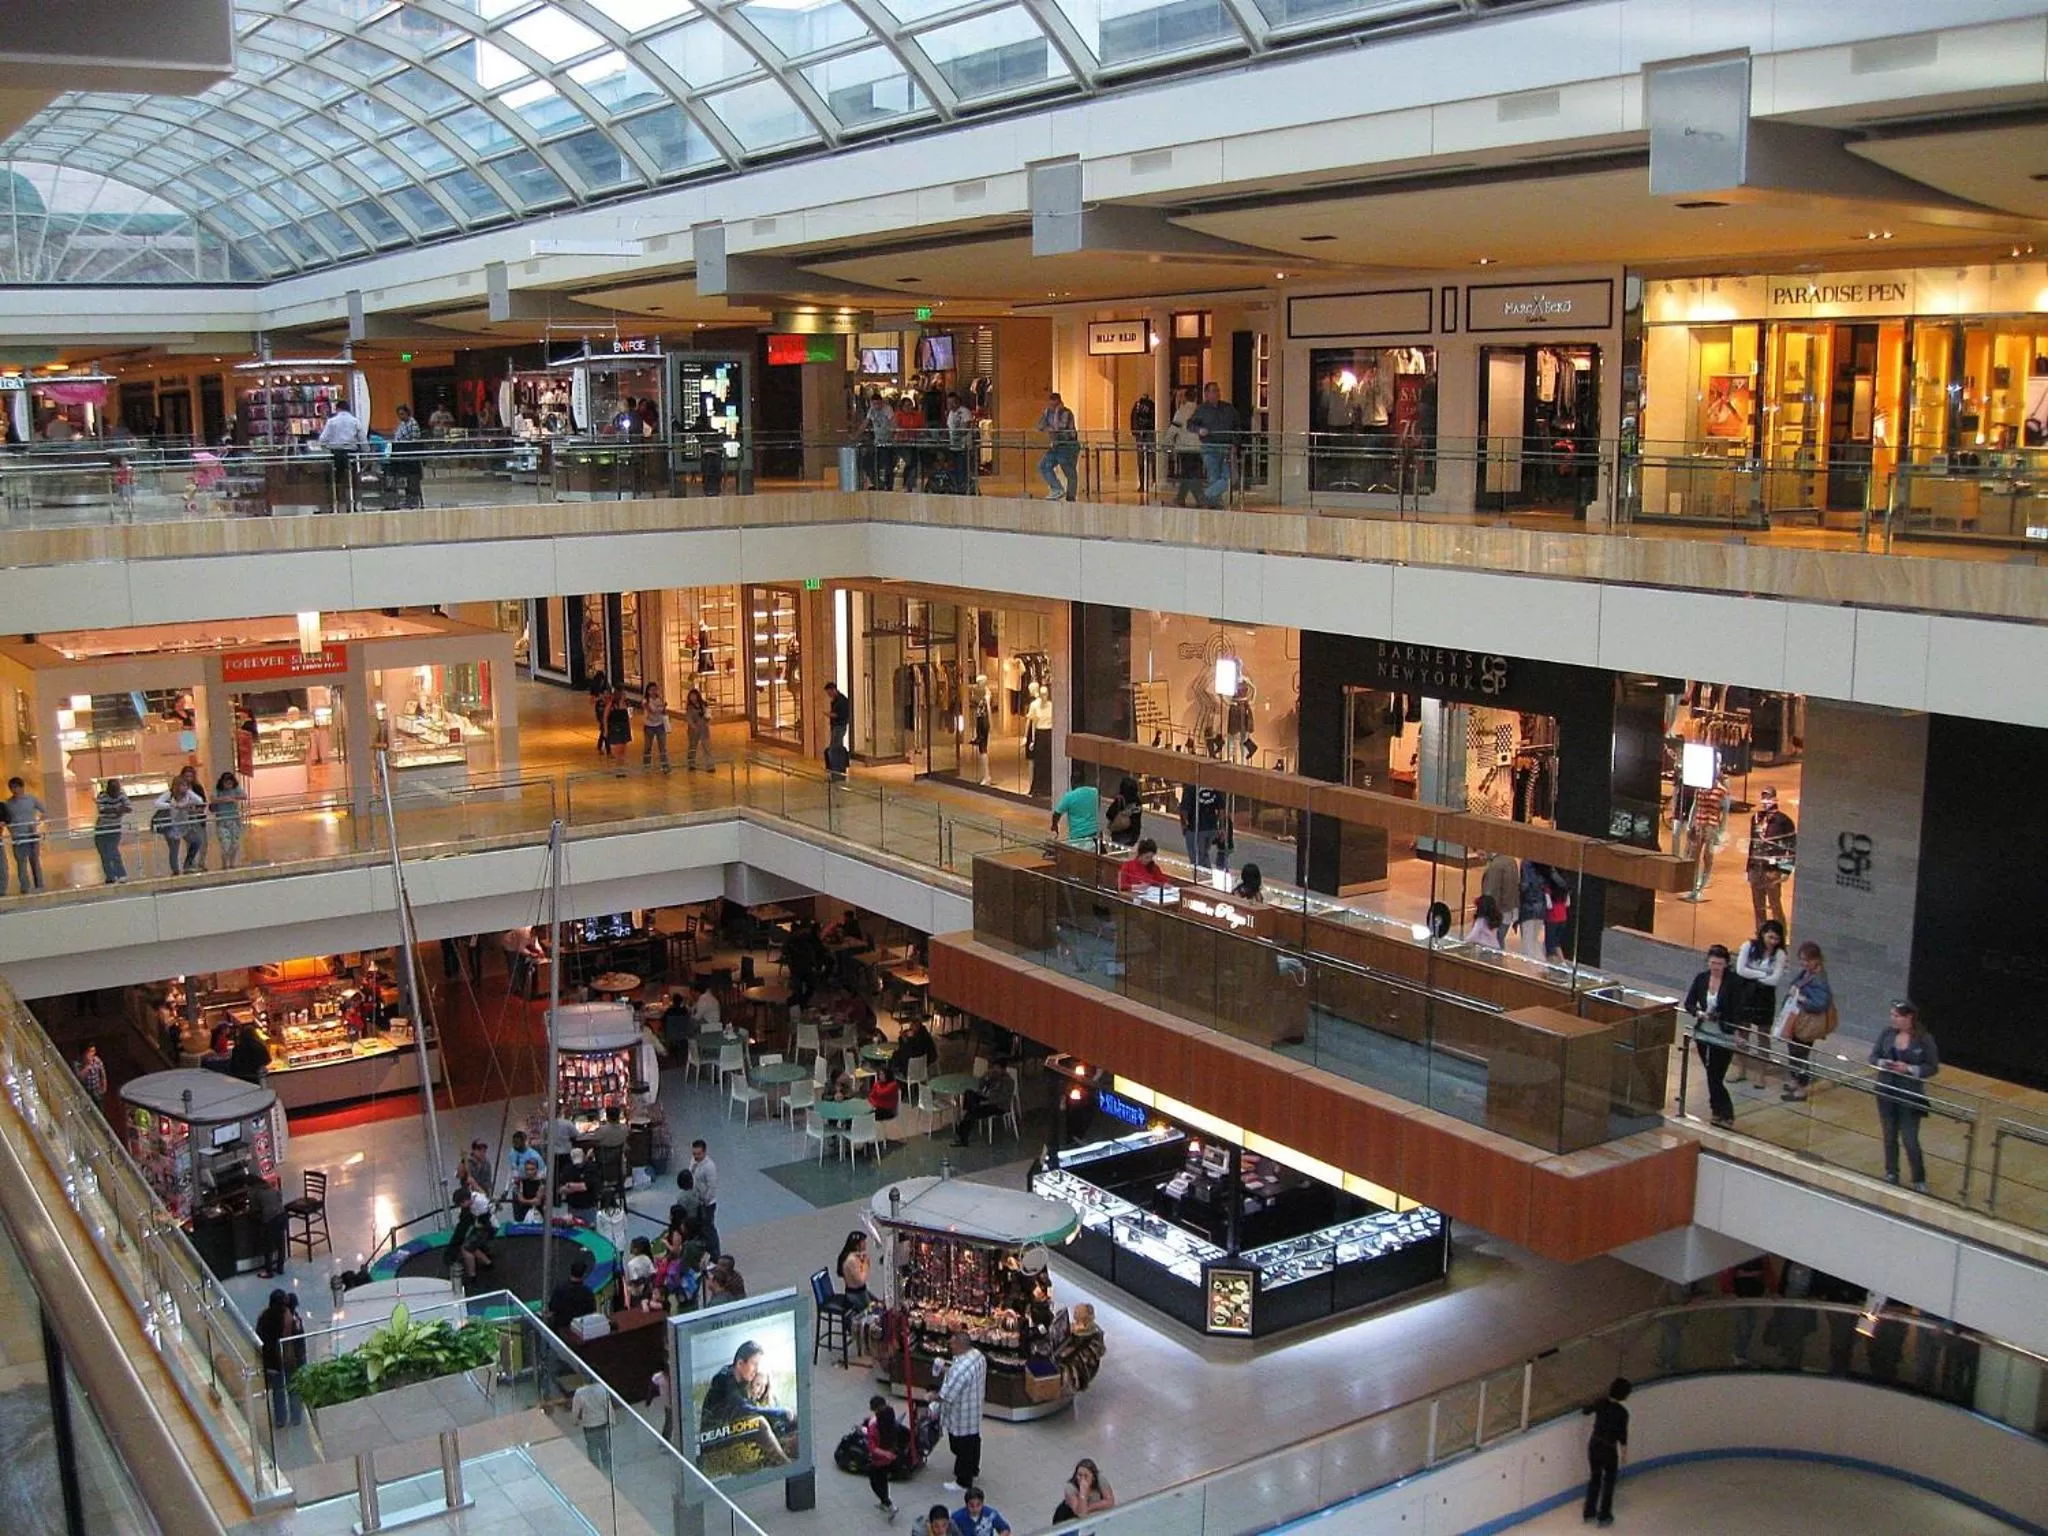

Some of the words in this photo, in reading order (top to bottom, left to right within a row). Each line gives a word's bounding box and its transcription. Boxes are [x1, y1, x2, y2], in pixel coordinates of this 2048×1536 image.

[1774, 285, 1863, 304] PARADISE
[1867, 283, 1906, 301] PEN
[225, 656, 285, 670] FOREVER
[1378, 642, 1474, 669] BARNEYS
[701, 1426, 731, 1443] DEAR
[730, 1418, 760, 1434] JOHN
